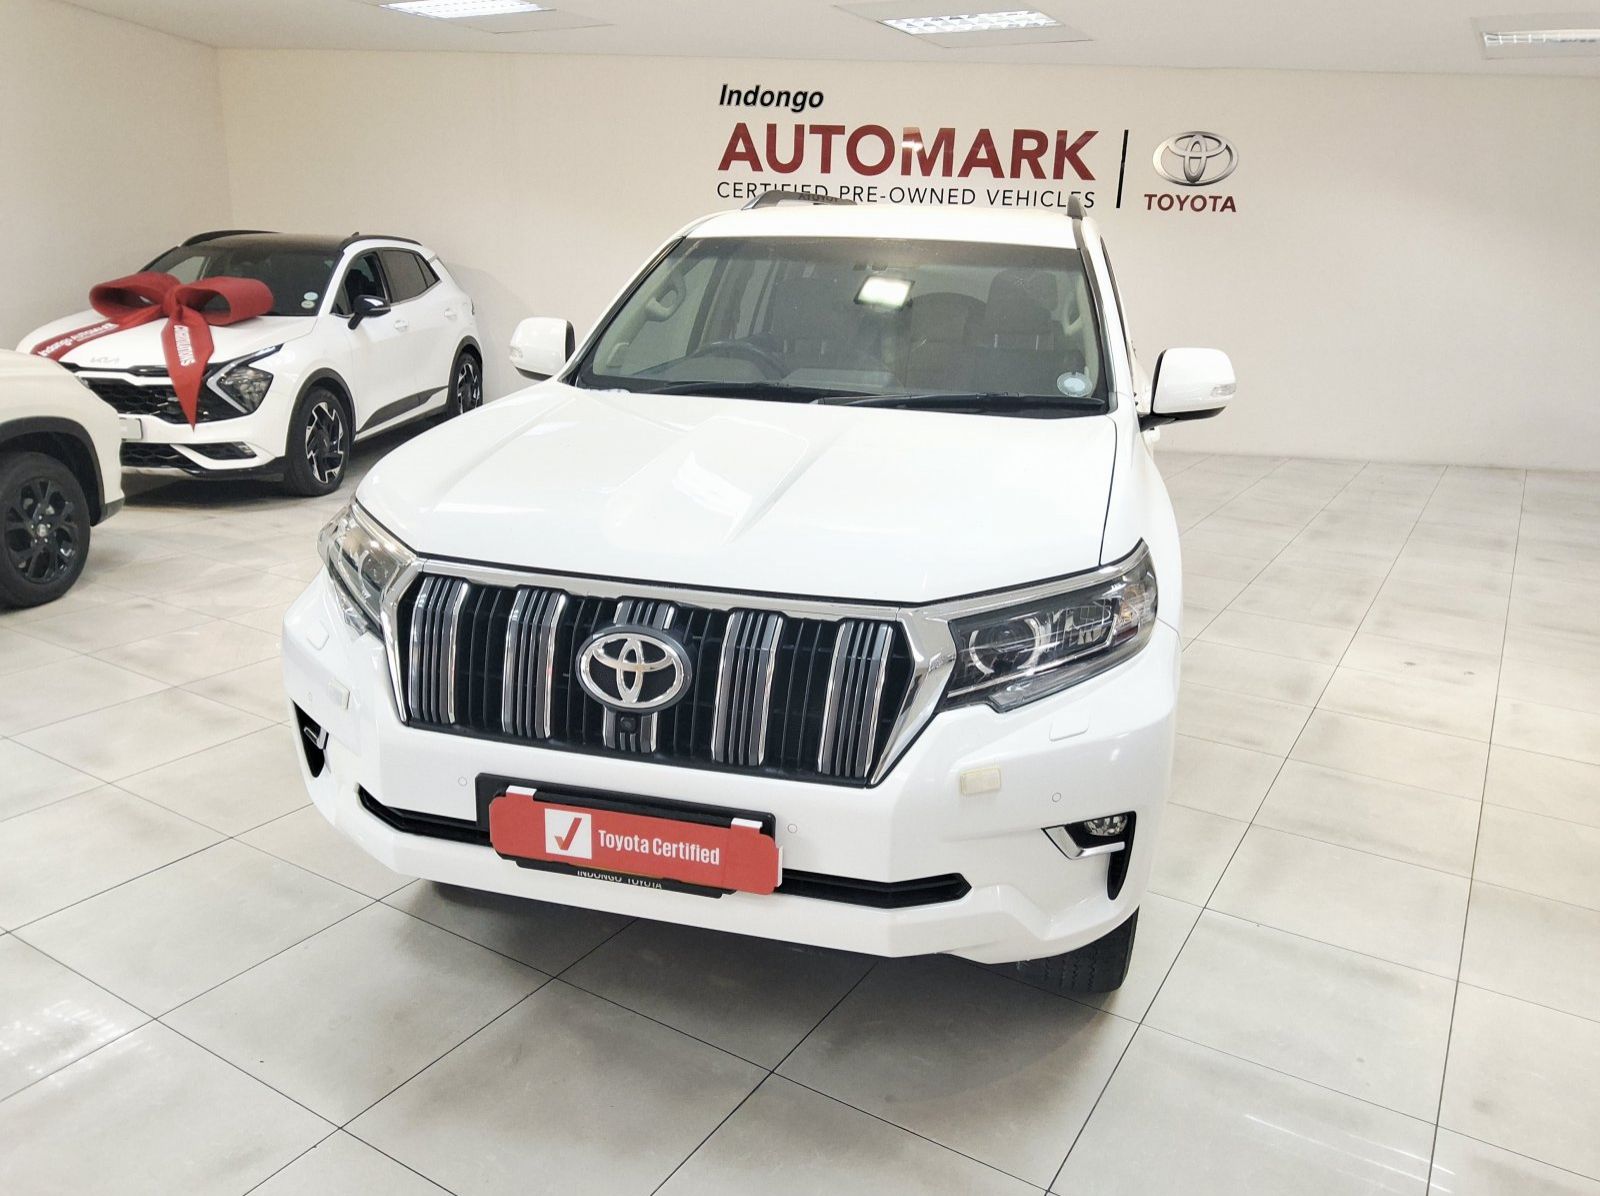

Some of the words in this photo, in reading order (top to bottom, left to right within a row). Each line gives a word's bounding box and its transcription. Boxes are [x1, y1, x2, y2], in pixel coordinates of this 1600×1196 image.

[719, 84, 824, 113] Indongo
[718, 123, 1099, 180] AUTOMARK
[840, 186, 976, 205] PRE-OWNED
[986, 190, 1096, 209] VEHICLS
[1144, 193, 1237, 213] TOYOTA
[598, 829, 650, 854] Toyota
[652, 837, 721, 866] Certified
